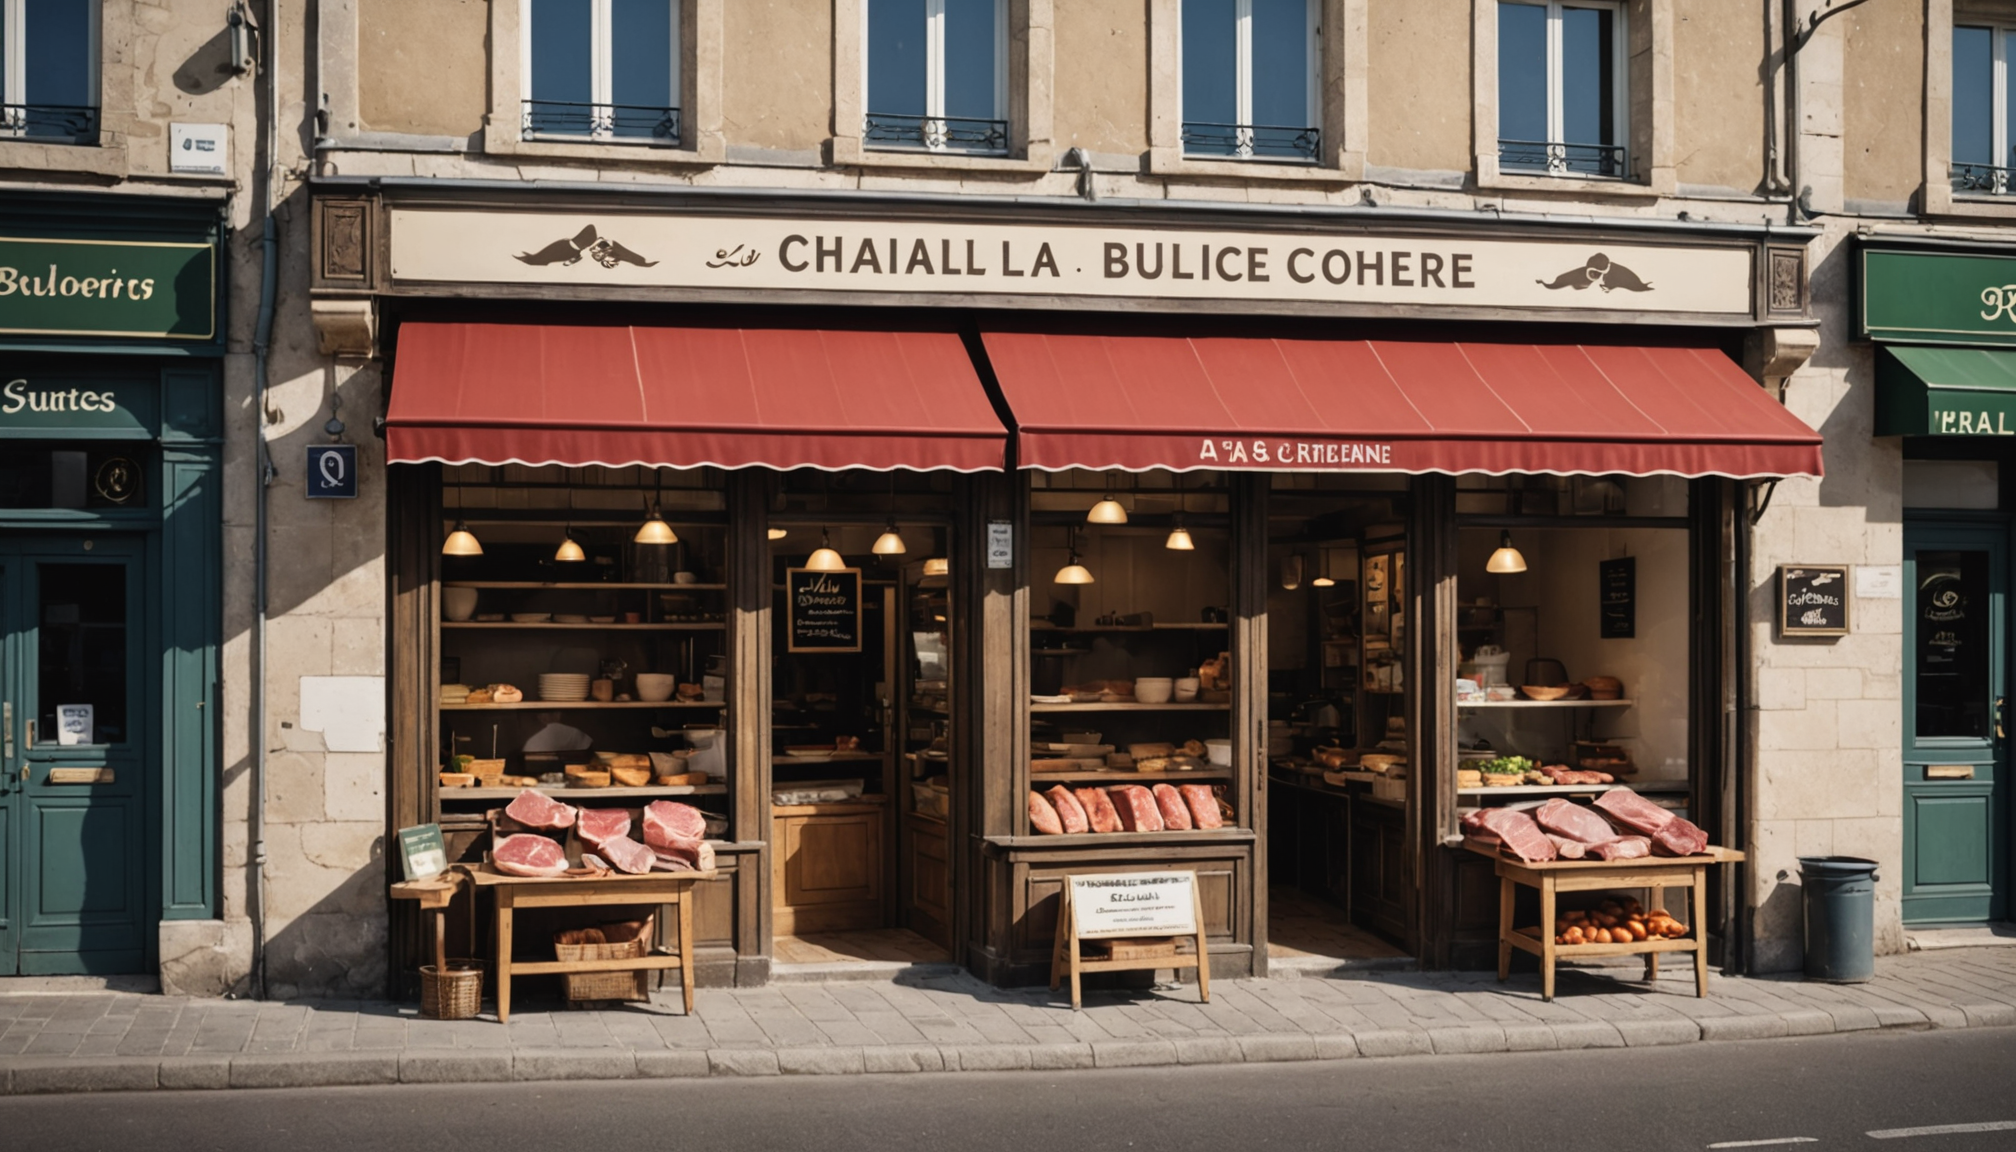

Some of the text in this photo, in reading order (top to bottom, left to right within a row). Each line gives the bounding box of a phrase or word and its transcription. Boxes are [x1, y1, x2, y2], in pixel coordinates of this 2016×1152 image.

[778, 234, 986, 276] CHAIALL
[1002, 240, 1061, 278] LA
[1103, 242, 1270, 283] BULICE
[1286, 247, 1476, 289] COHERE
